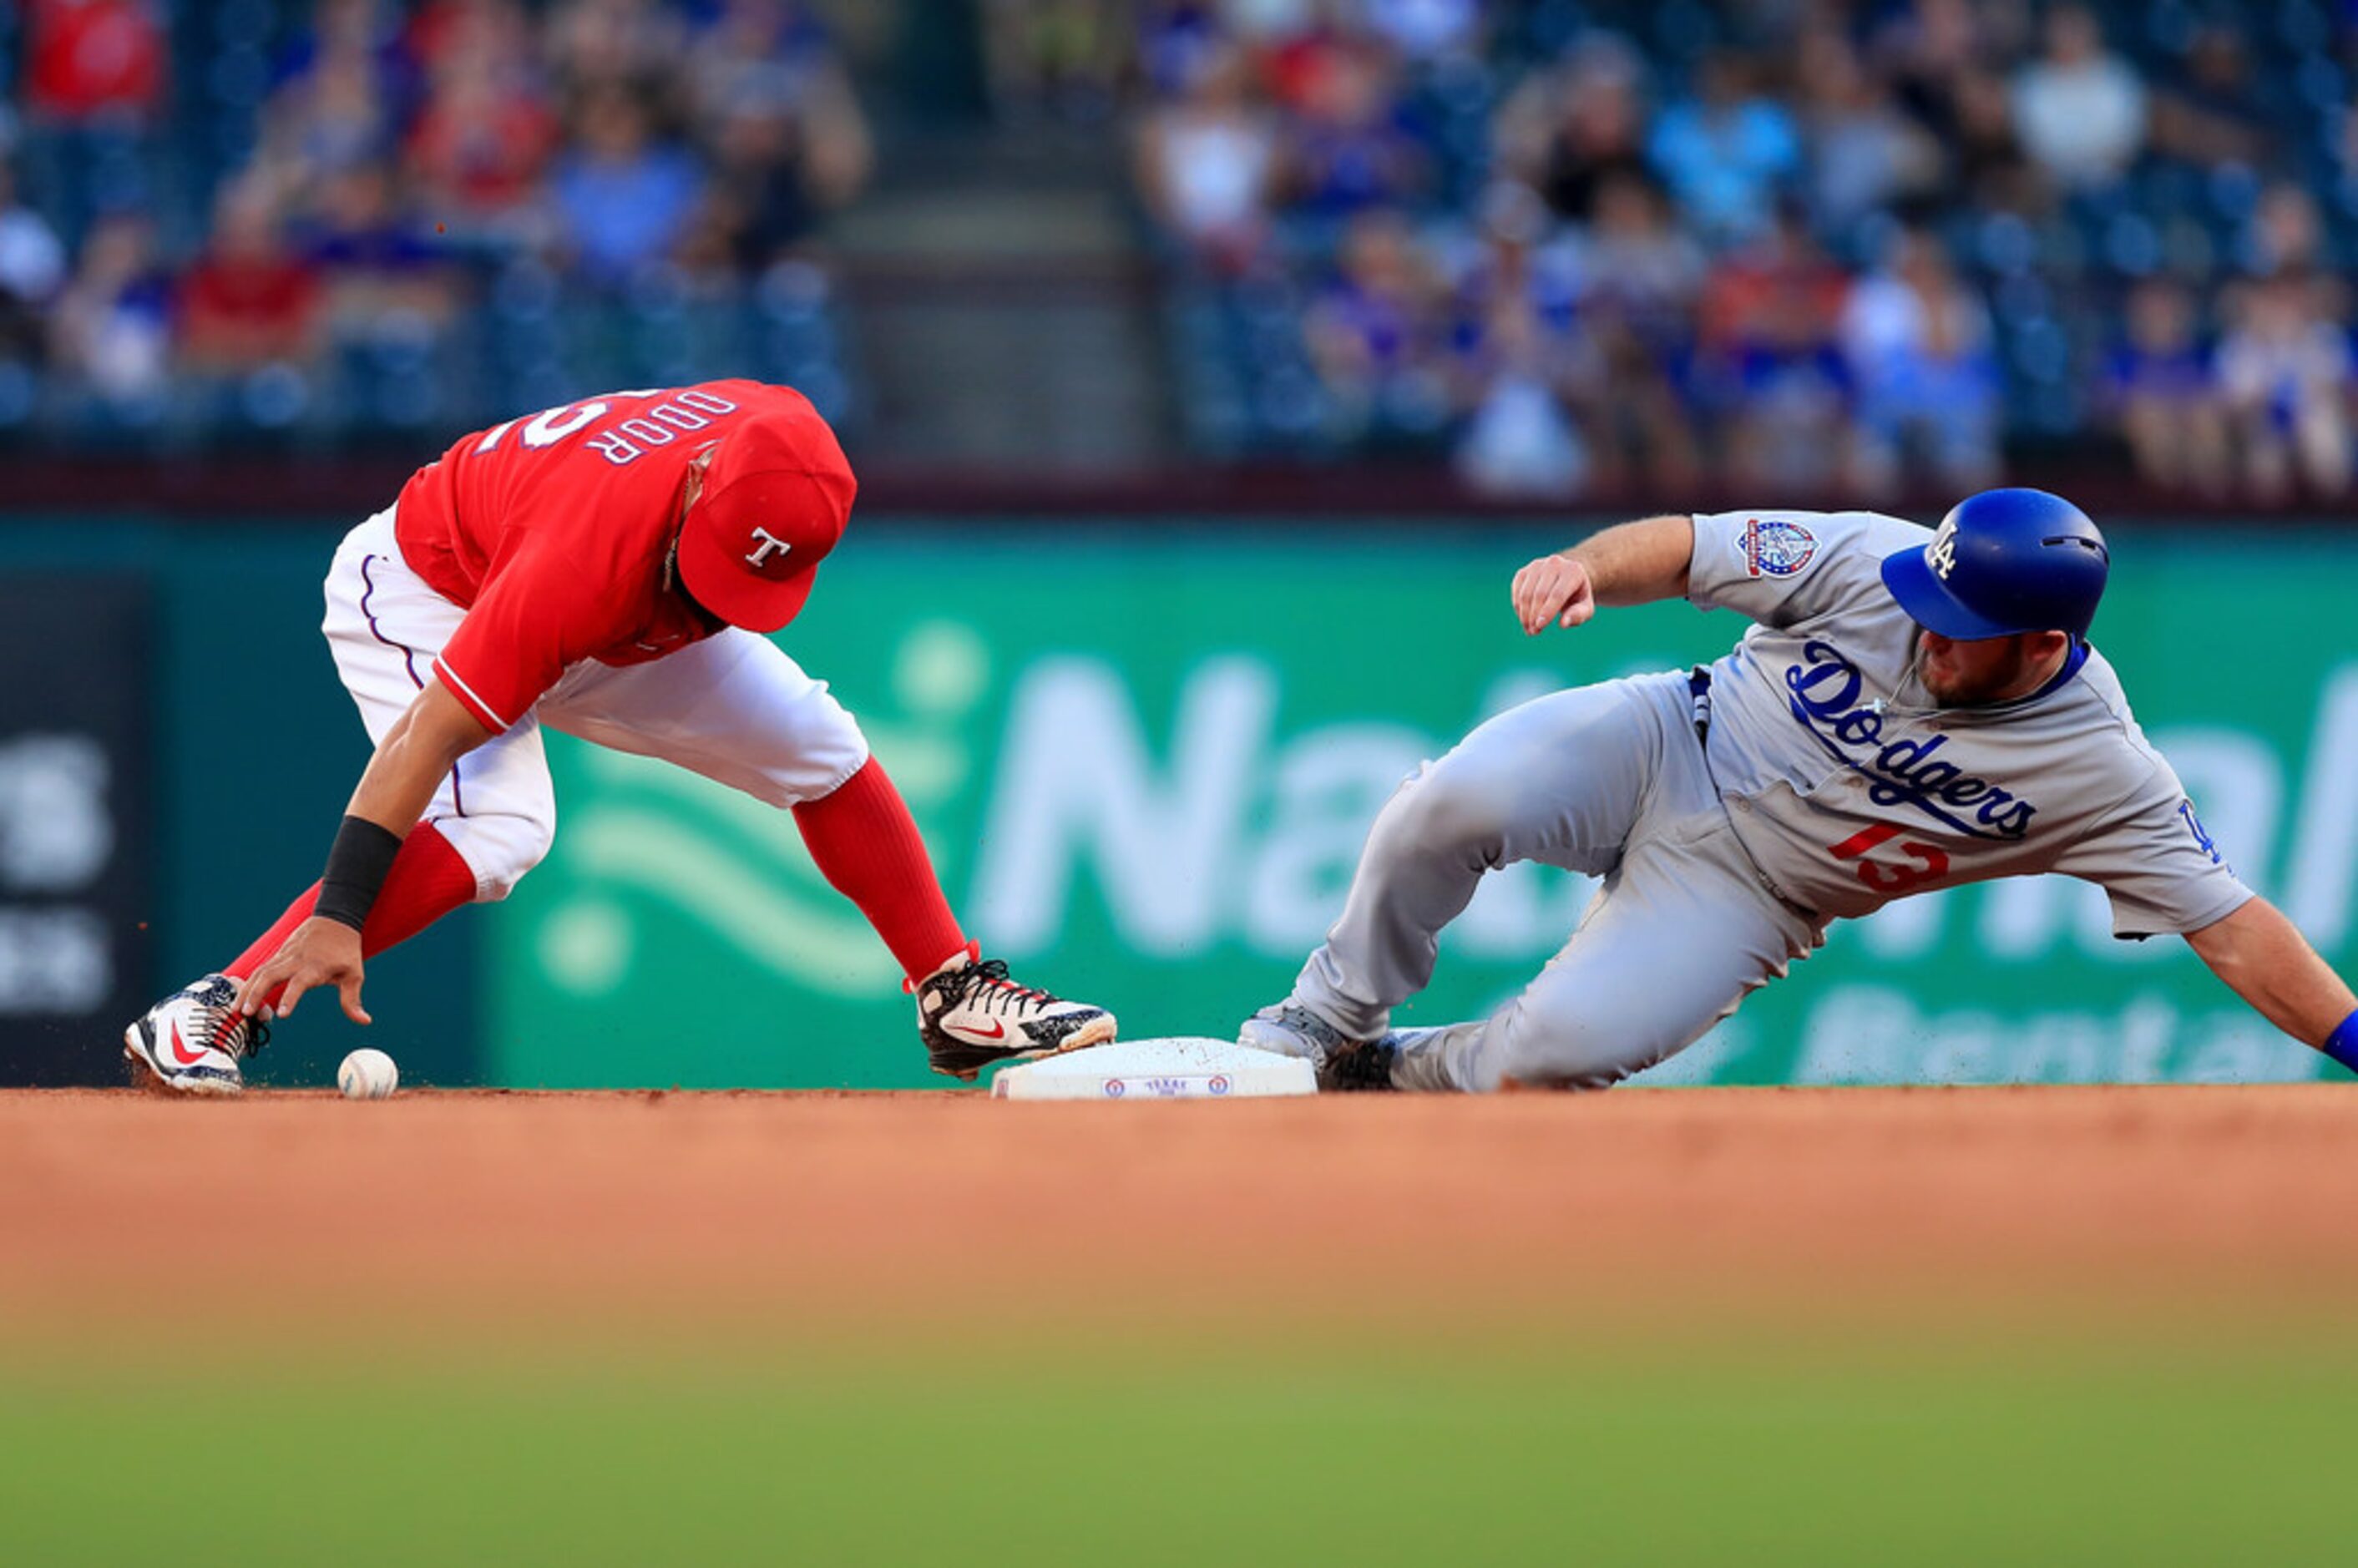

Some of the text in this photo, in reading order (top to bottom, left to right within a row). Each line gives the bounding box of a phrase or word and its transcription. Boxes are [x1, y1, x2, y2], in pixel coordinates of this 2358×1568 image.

[585, 391, 738, 465] ODOR
[745, 526, 791, 567] T
[1785, 640, 2037, 841] Dodgers
[1827, 821, 1949, 892] 13
